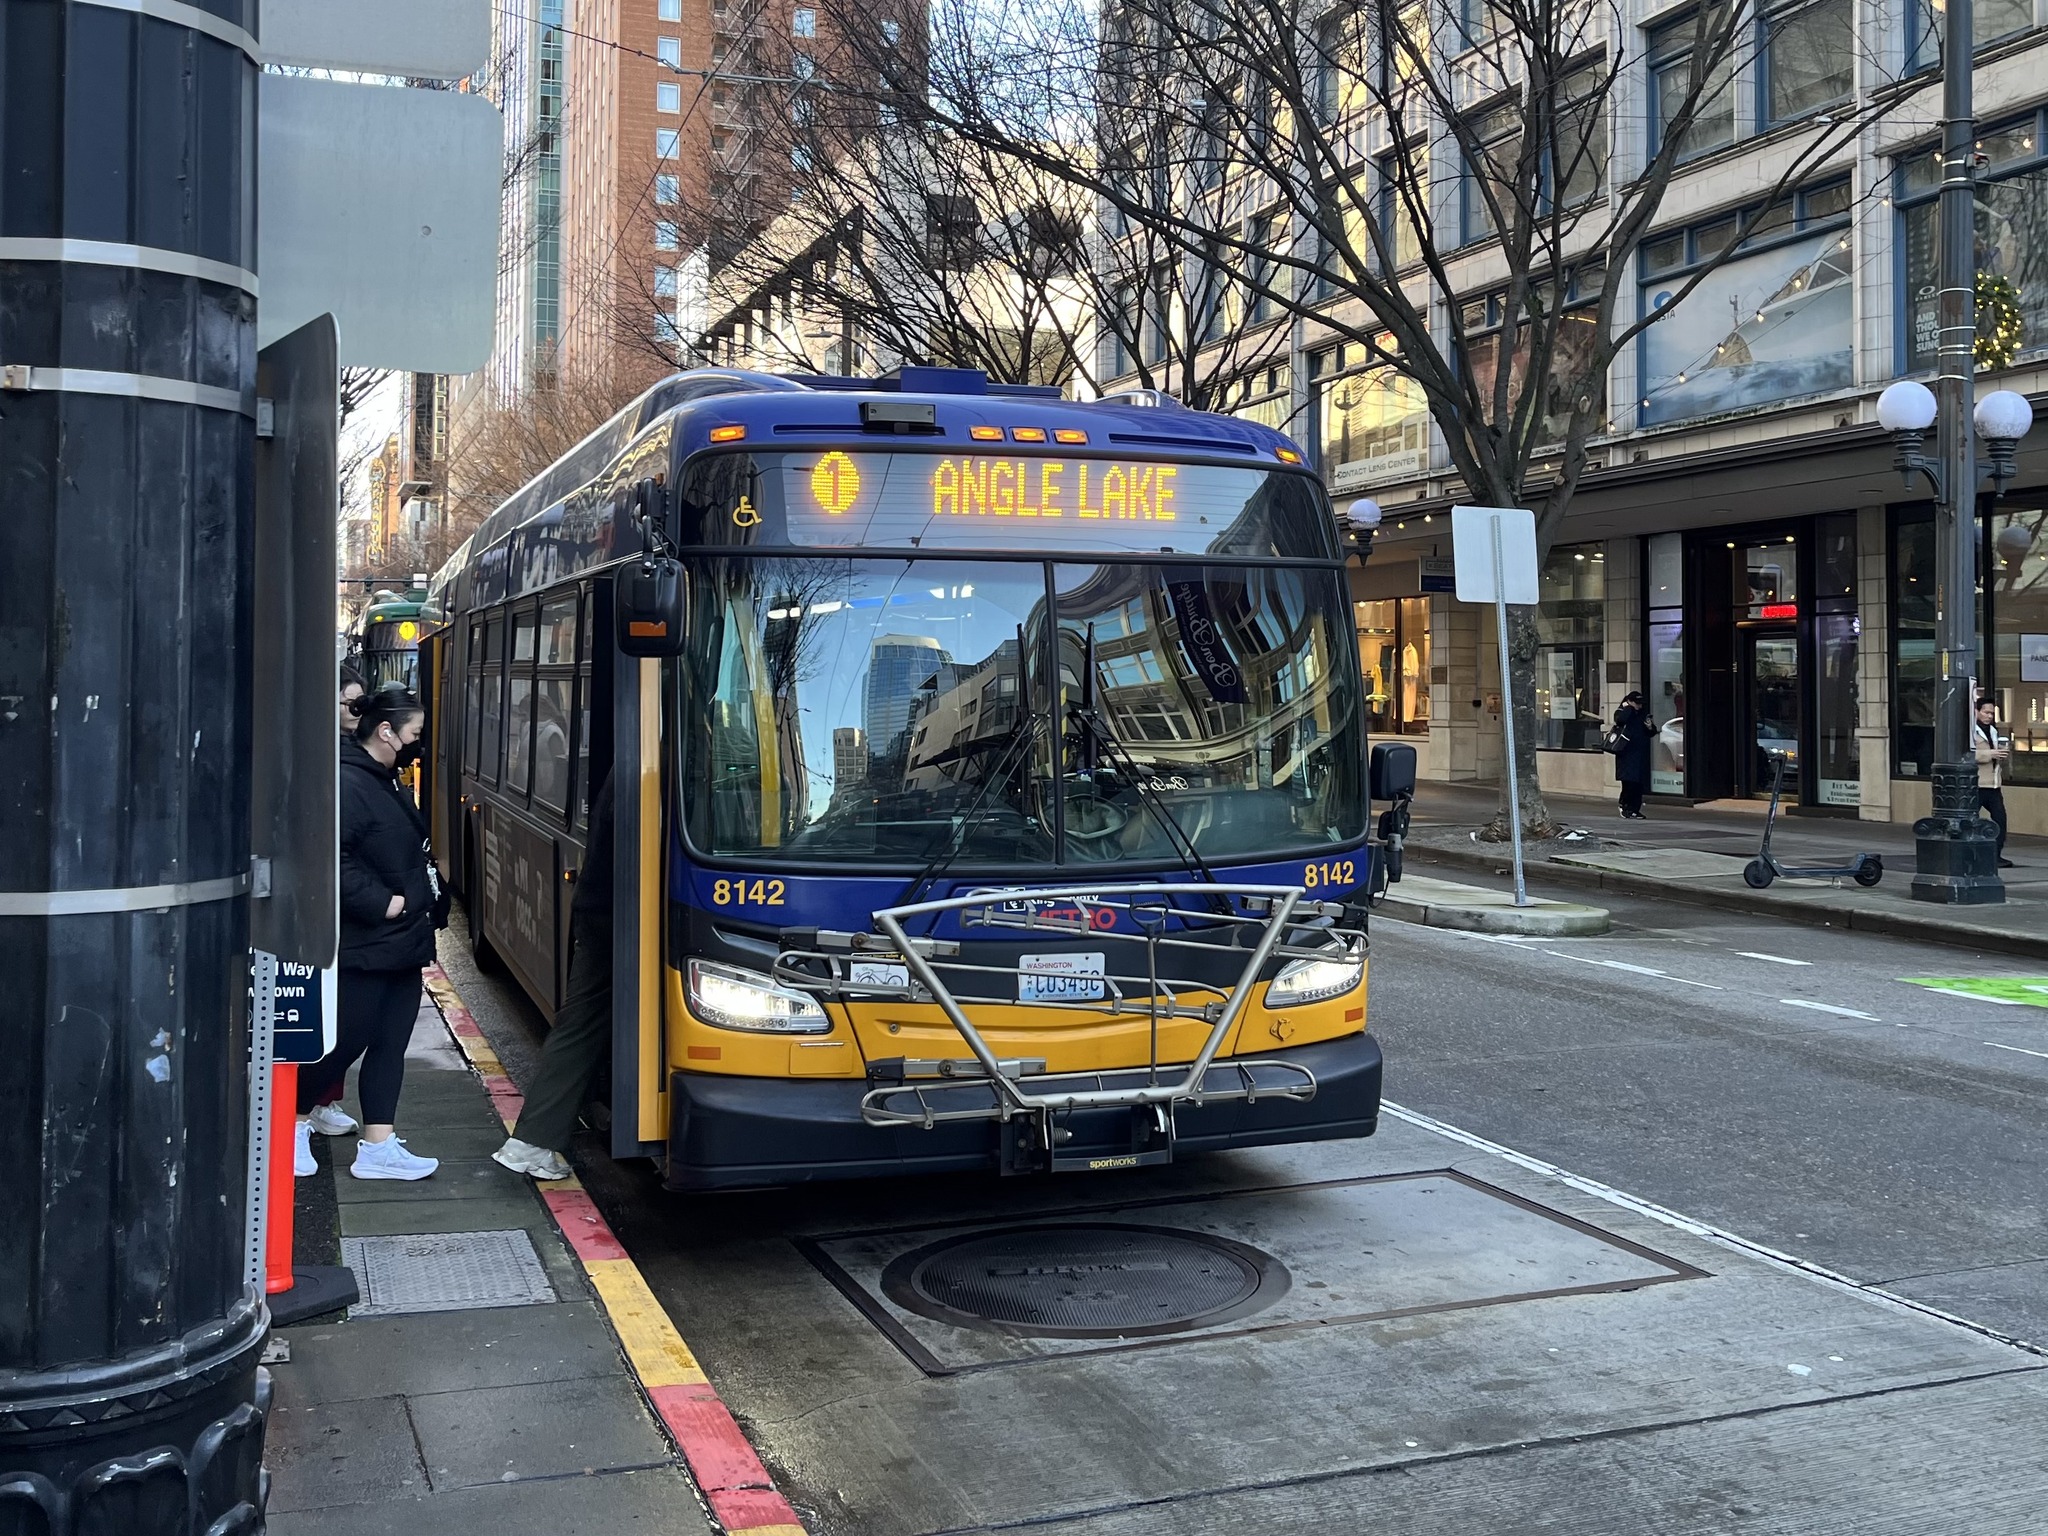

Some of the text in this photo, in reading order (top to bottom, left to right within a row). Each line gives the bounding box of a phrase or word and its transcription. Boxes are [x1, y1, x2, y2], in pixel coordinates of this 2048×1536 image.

[1916, 311, 1936, 324] AND
[1916, 332, 1930, 342] WE
[1337, 457, 1416, 479] CONTACT LENS CENTER
[934, 459, 1063, 516] ANGLE
[1079, 464, 1177, 520] LAKE
[1305, 860, 1355, 888] 8142
[713, 879, 785, 905] 8142
[283, 962, 314, 980] Way
[1089, 1156, 1138, 1170] sportworks
